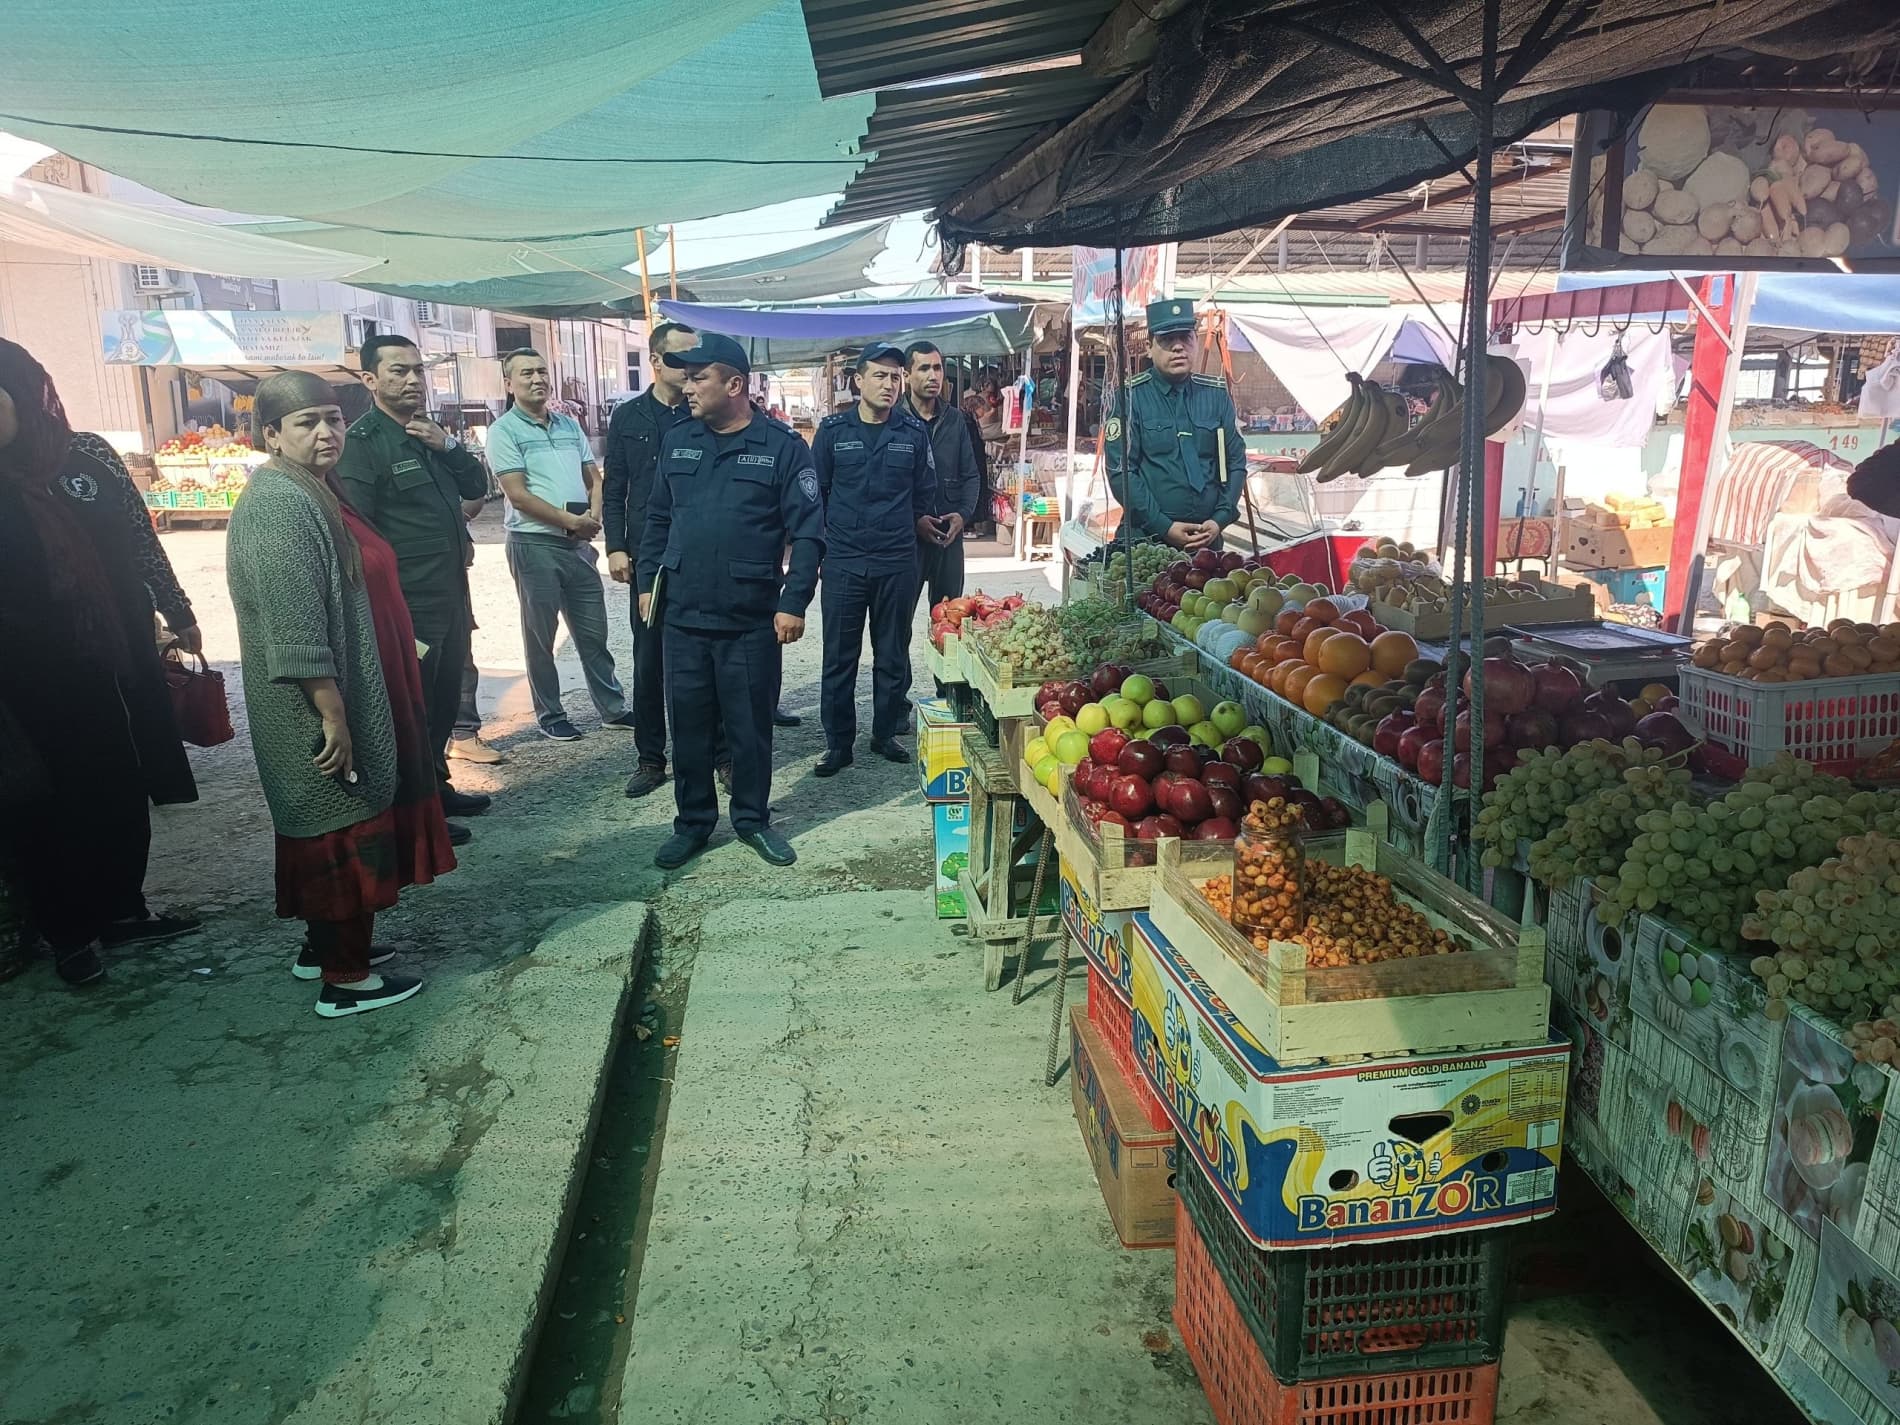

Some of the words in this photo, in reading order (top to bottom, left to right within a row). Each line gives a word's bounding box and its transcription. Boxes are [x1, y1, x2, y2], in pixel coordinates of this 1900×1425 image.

[1829, 434, 1858, 450] 149
[1357, 1068, 1408, 1082] PREMIUM
[1409, 1064, 1440, 1076] GOLD
[1440, 1060, 1487, 1073] BANANA
